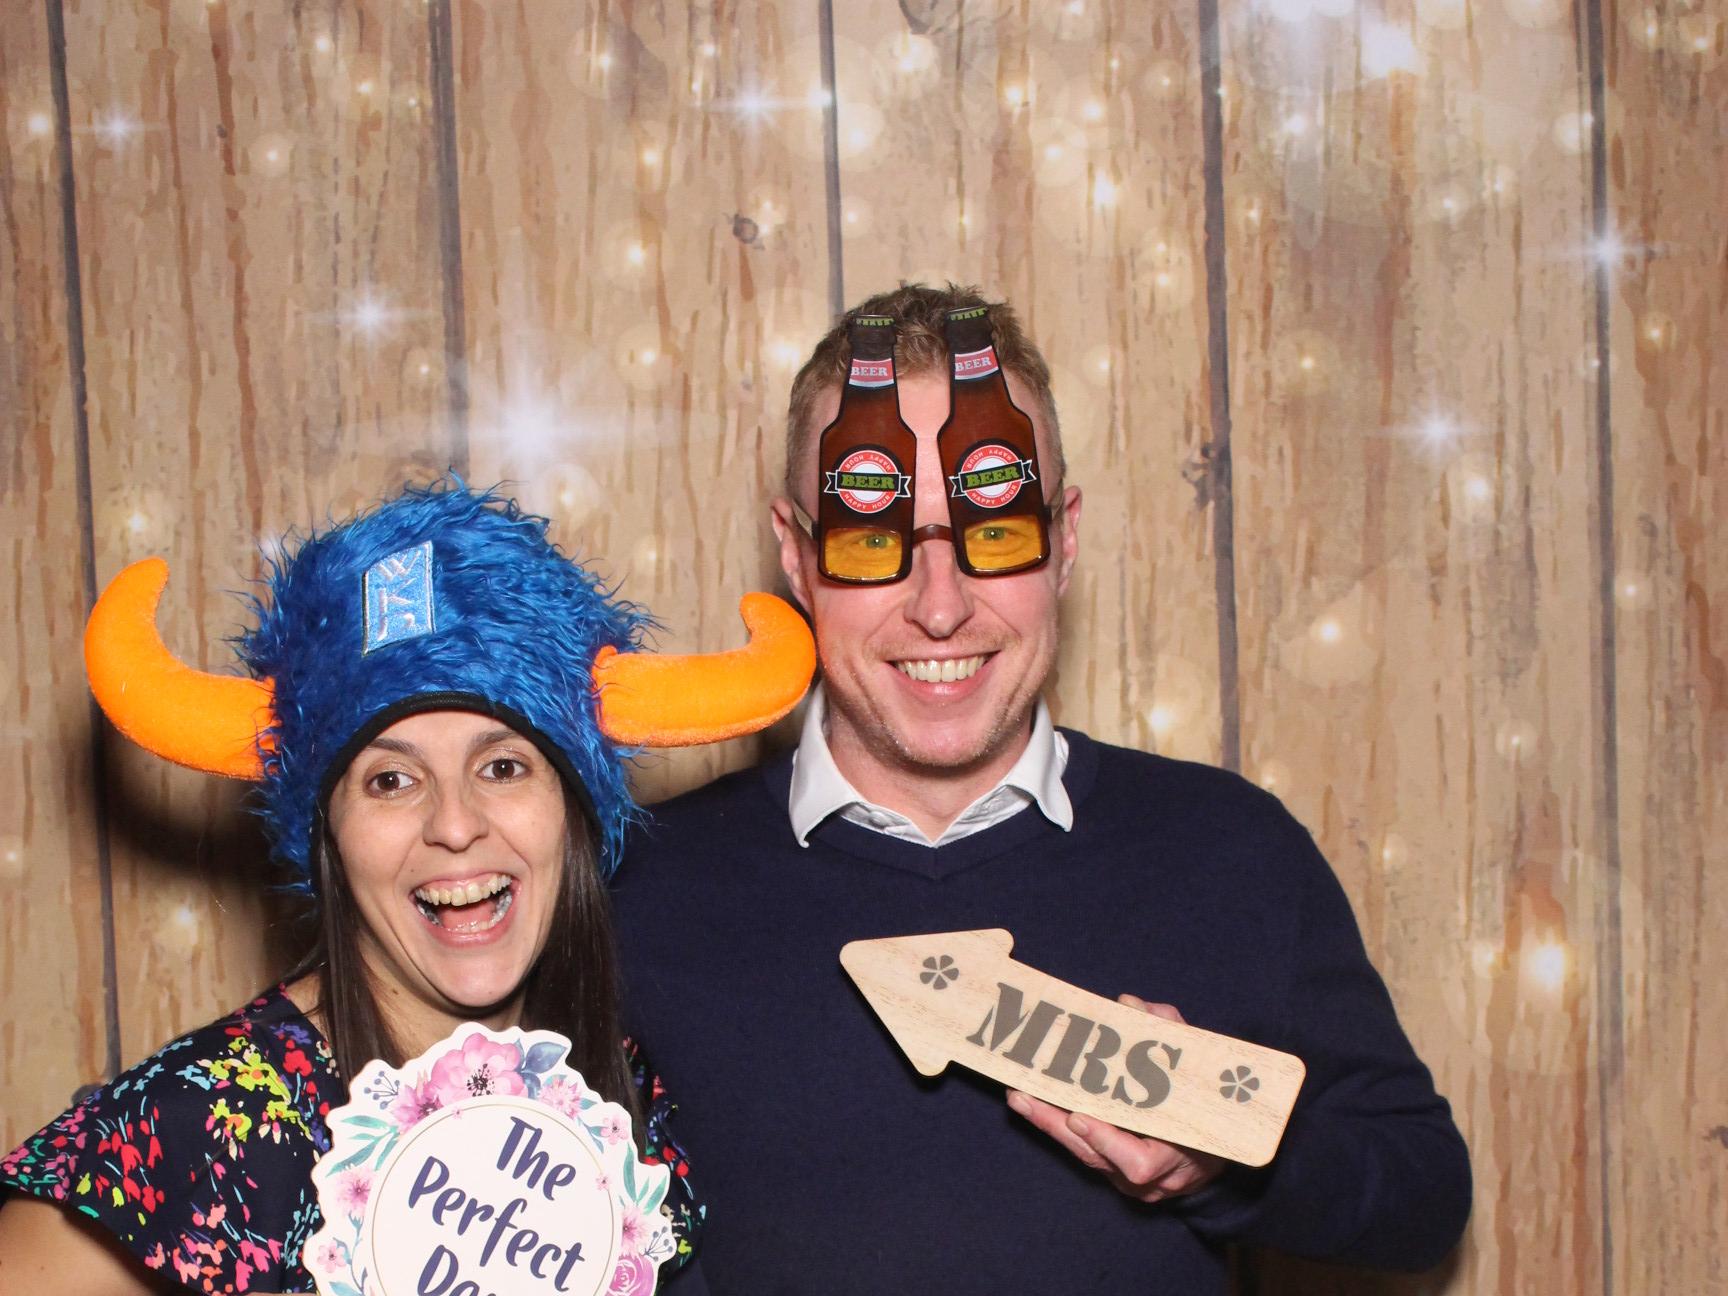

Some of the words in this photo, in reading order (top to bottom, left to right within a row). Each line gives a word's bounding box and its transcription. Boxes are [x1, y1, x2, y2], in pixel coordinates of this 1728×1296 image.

[851, 366, 888, 377] BEER
[955, 357, 992, 372] BEER
[989, 449, 1013, 461] HAPPY
[841, 474, 895, 489] BEER
[967, 466, 1019, 488] BEER
[844, 493, 867, 509] HAPPY
[872, 495, 891, 509] HOUR
[971, 492, 996, 505] HAPPY
[1001, 484, 1018, 502] HOUR
[966, 982, 1183, 1109] MRS
[496, 1115, 577, 1201] The
[408, 1155, 585, 1292] Perfect
